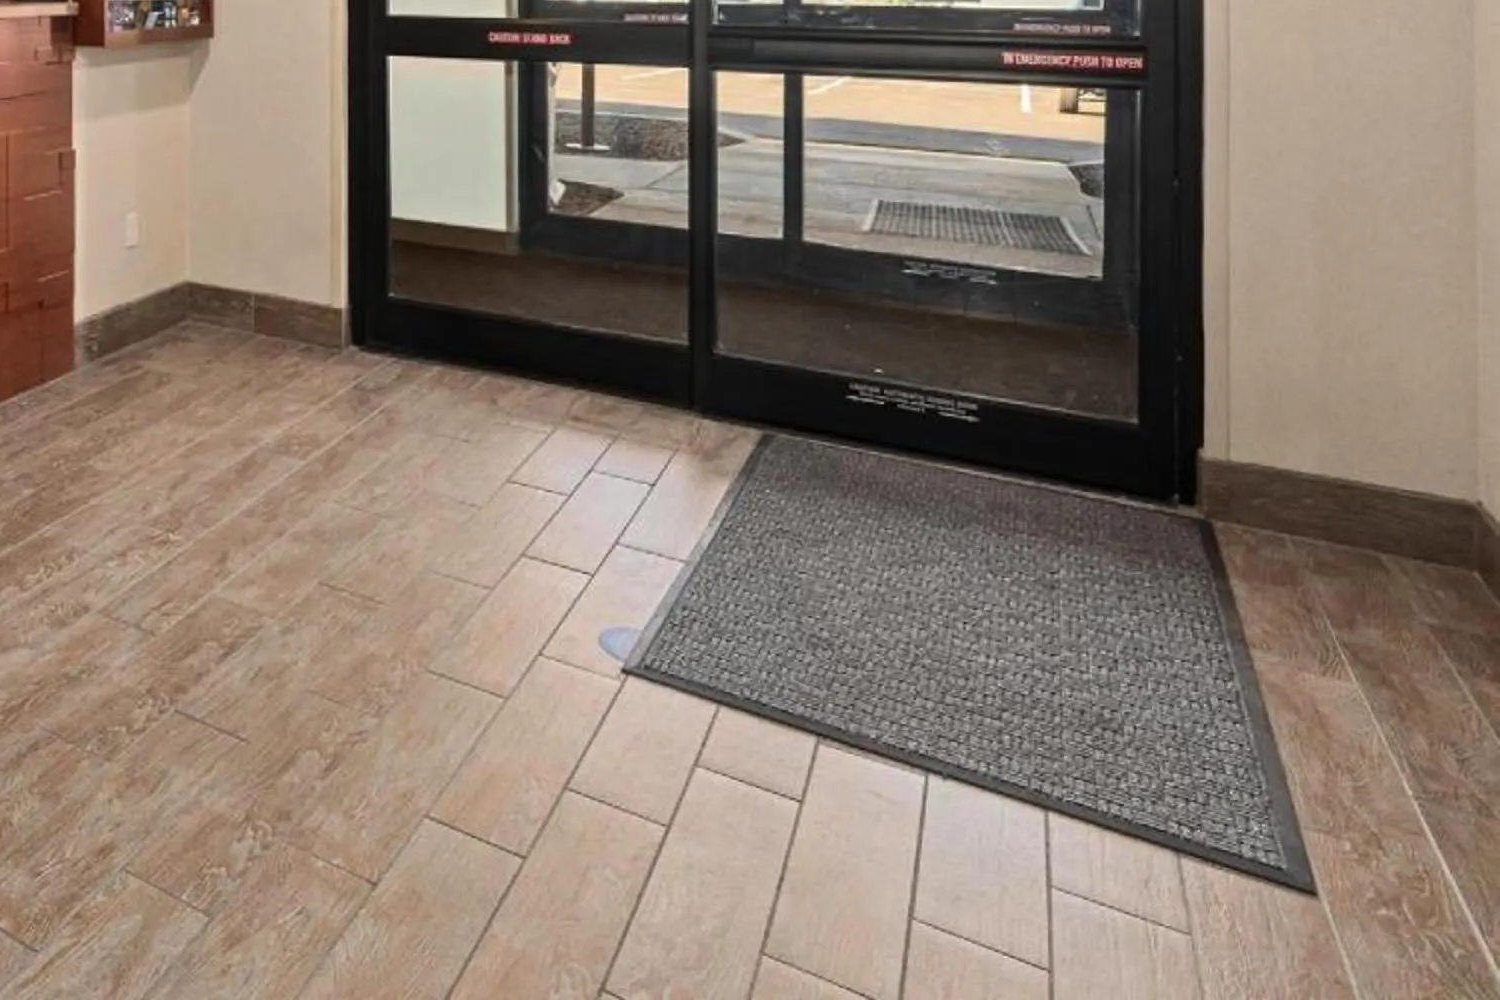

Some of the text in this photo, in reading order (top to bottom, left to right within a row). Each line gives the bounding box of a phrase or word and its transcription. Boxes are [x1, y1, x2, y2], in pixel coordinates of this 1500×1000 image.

[1074, 56, 1099, 68] PUSH
[1101, 56, 1114, 68] TO
[1115, 57, 1144, 69] OPEN
